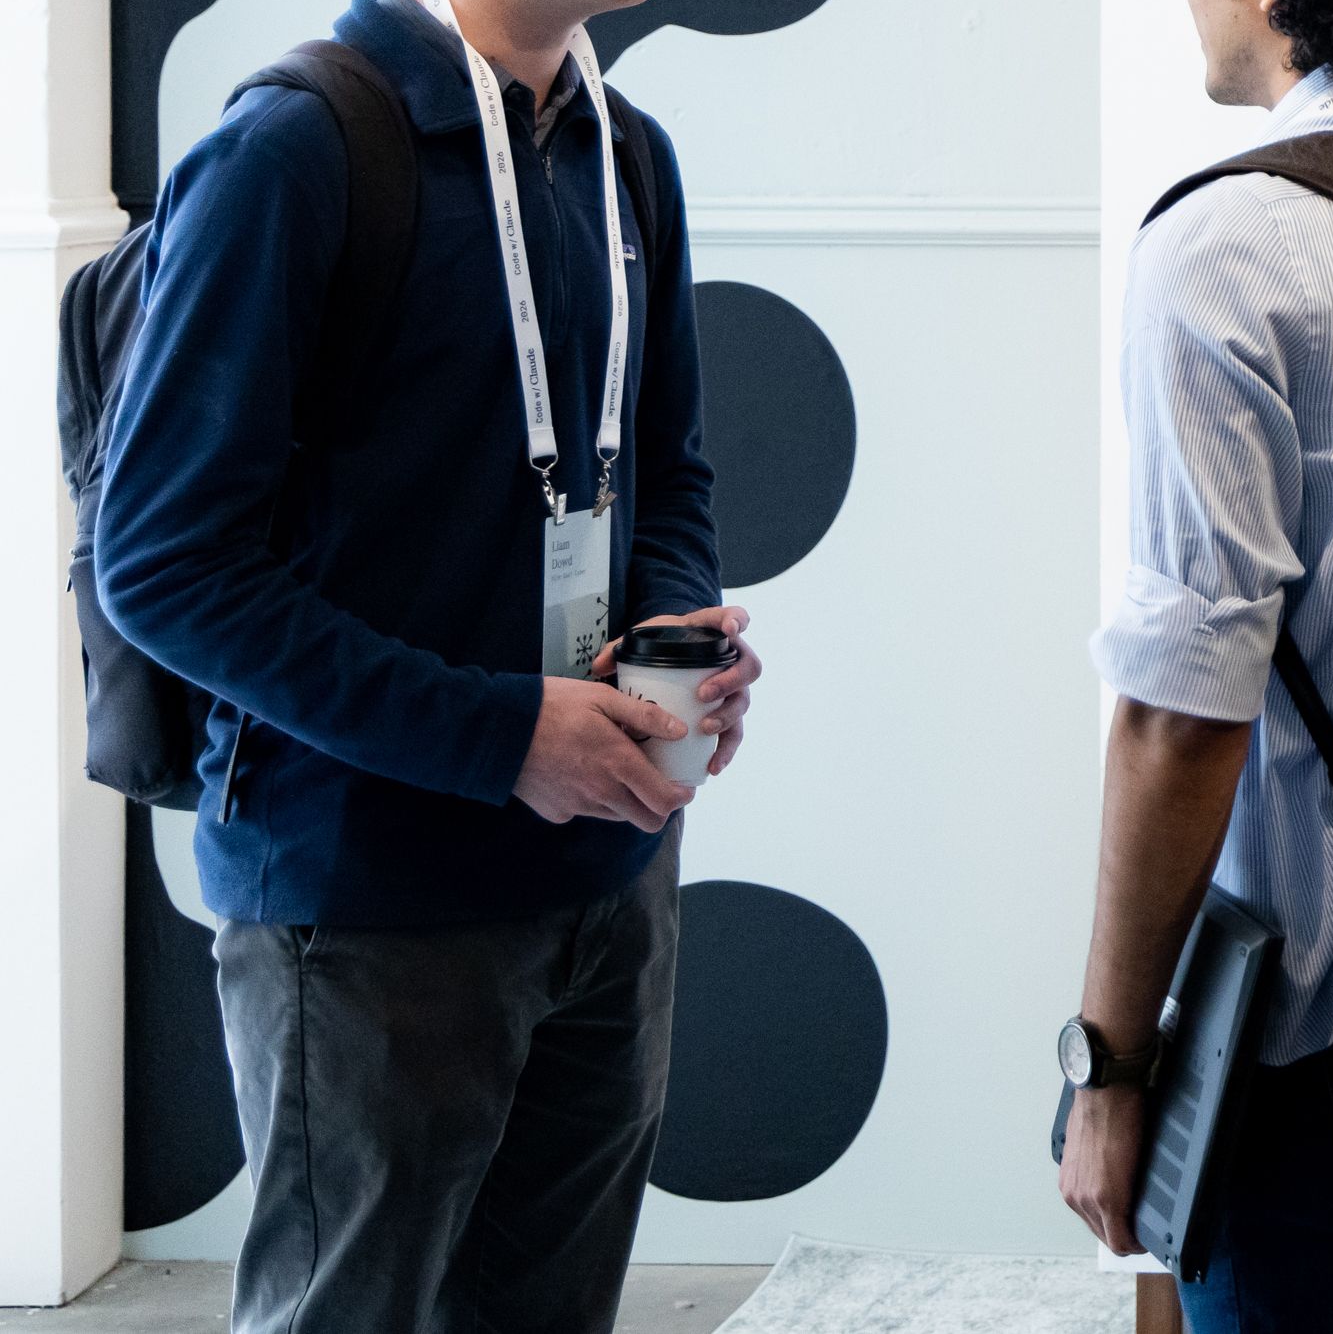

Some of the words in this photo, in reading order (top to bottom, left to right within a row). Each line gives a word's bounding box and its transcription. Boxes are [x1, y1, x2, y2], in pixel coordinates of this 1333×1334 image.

[474, 55, 491, 89] Claude
[583, 56, 594, 77] Code
[591, 79, 599, 91] w/
[483, 90, 494, 102] w/
[488, 103, 499, 127] Code
[496, 151, 507, 174] 2026
[505, 199, 515, 237] Claude
[511, 238, 518, 252] w/
[514, 252, 523, 275] Code
[521, 299, 530, 323] 2026
[613, 341, 621, 364] Code
[527, 347, 539, 386] Claude
[611, 366, 619, 378] w/
[534, 387, 542, 400] w/
[608, 380, 619, 417] Claude
[536, 400, 545, 424] Code
